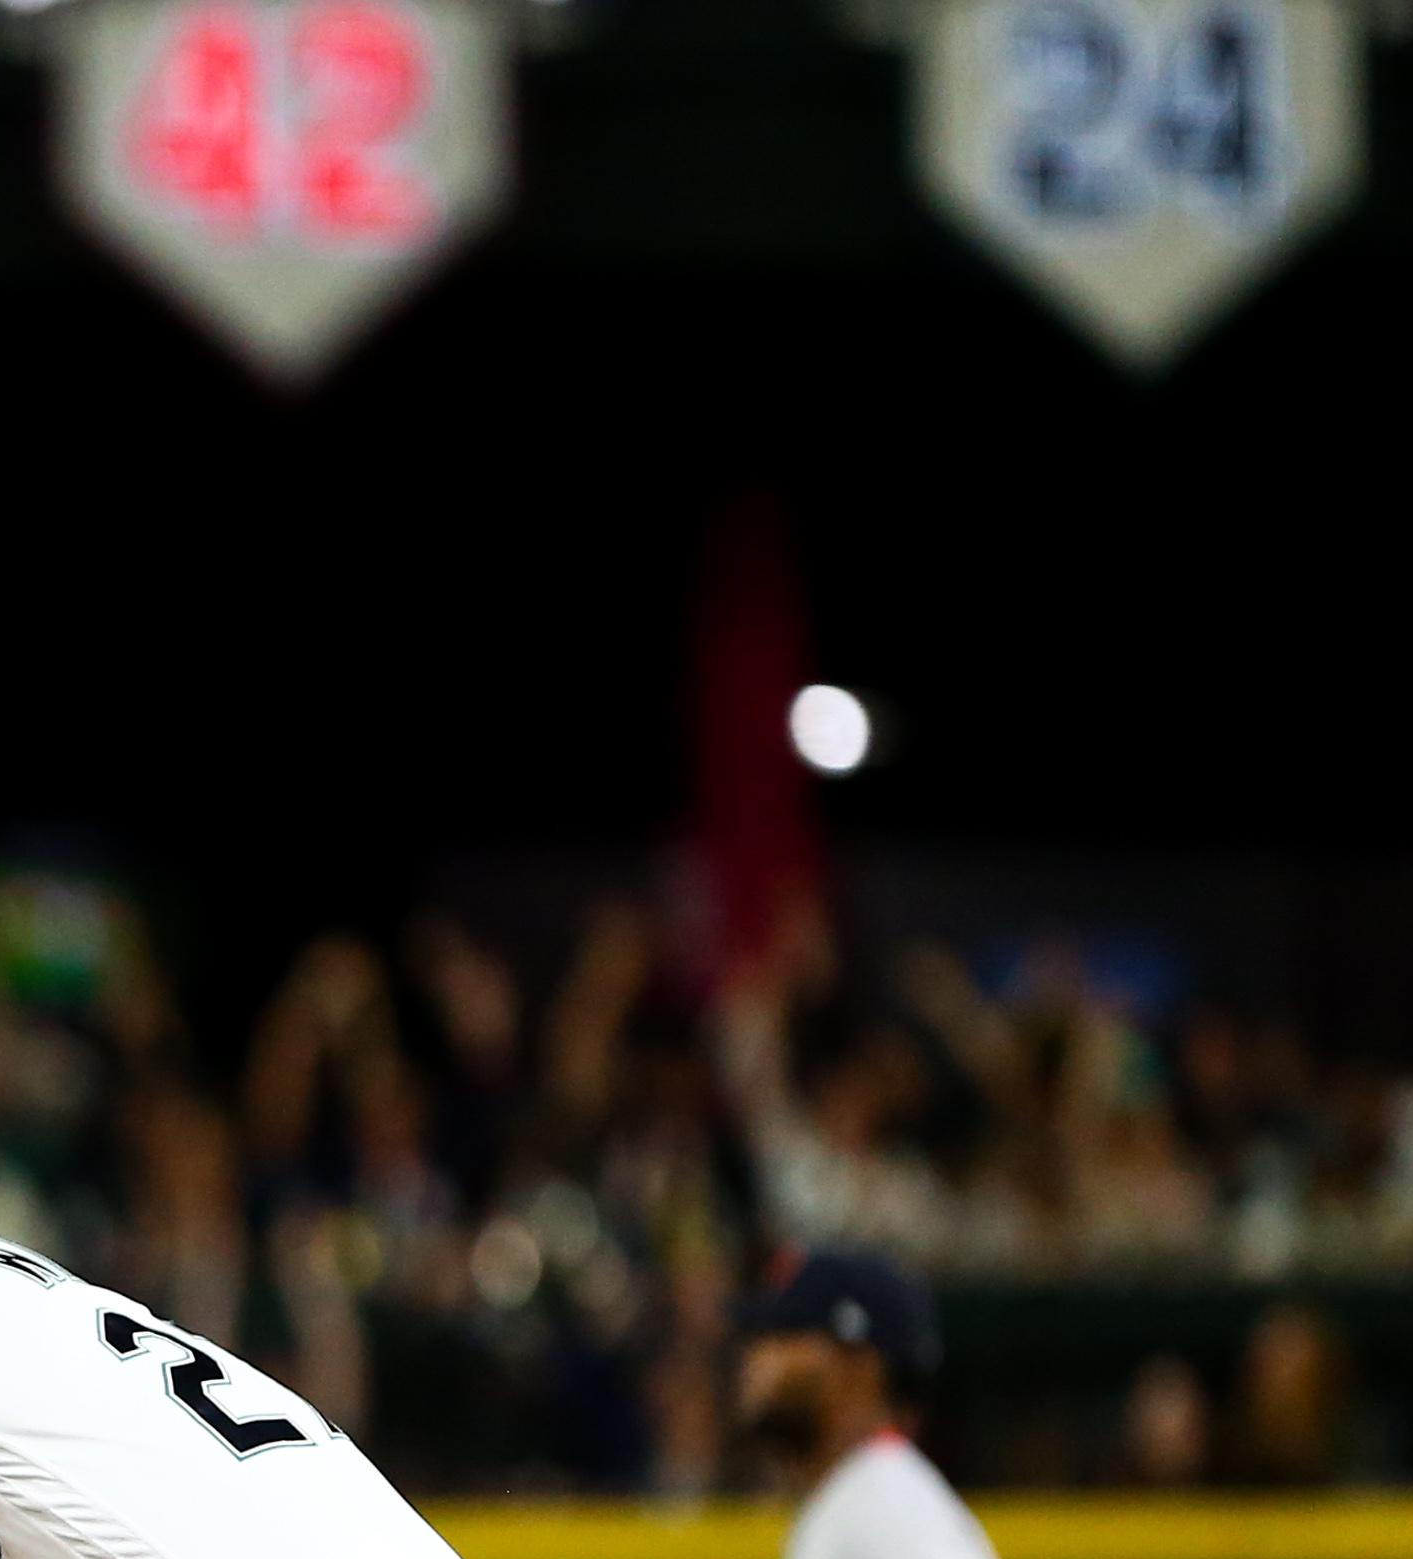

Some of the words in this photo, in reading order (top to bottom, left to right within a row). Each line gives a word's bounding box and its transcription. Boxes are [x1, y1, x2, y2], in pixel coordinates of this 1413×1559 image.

[119, 0, 446, 245] 42
[999, 0, 1282, 222] 24
[96, 1308, 350, 1462] 2
